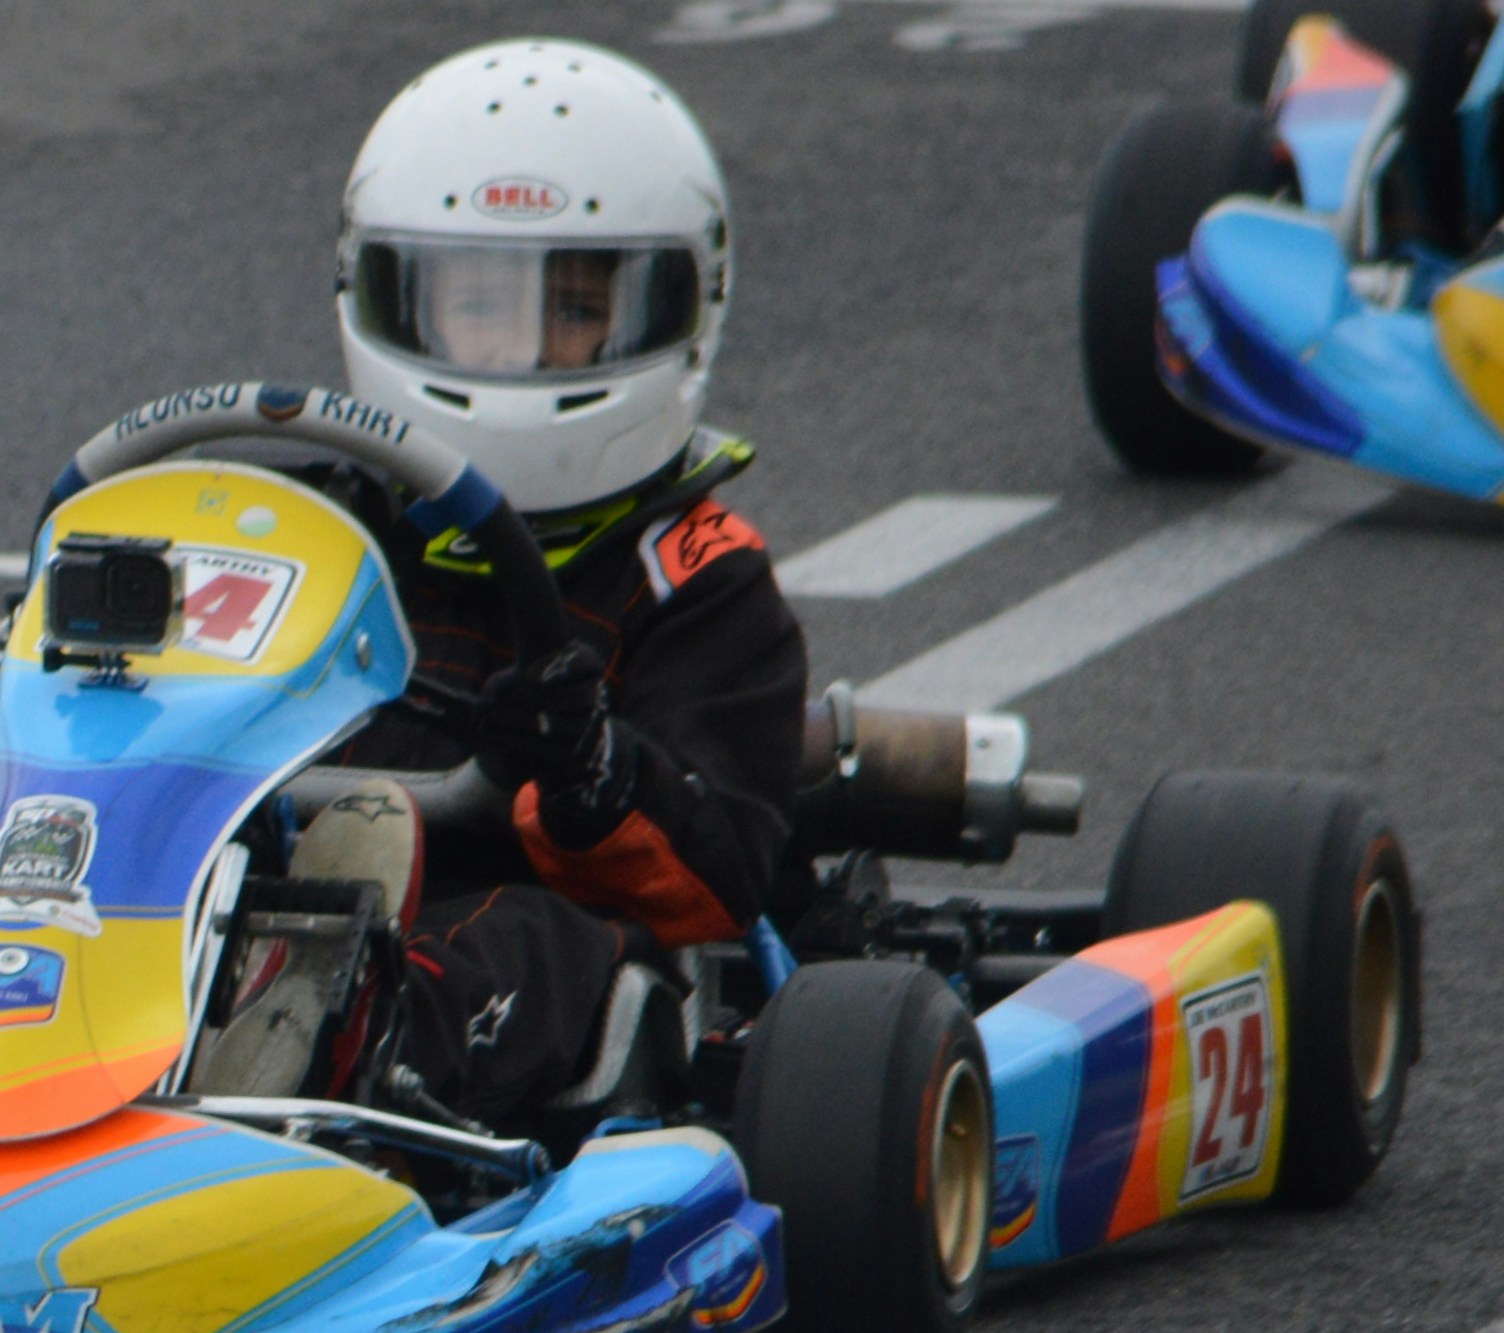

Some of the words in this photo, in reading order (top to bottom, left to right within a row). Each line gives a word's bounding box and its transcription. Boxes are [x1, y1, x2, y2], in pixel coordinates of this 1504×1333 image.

[486, 187, 554, 207] BELL
[319, 391, 411, 445] KART
[185, 555, 274, 576] ARTHY
[184, 573, 274, 643] 4
[1191, 1012, 1265, 1168] 24
